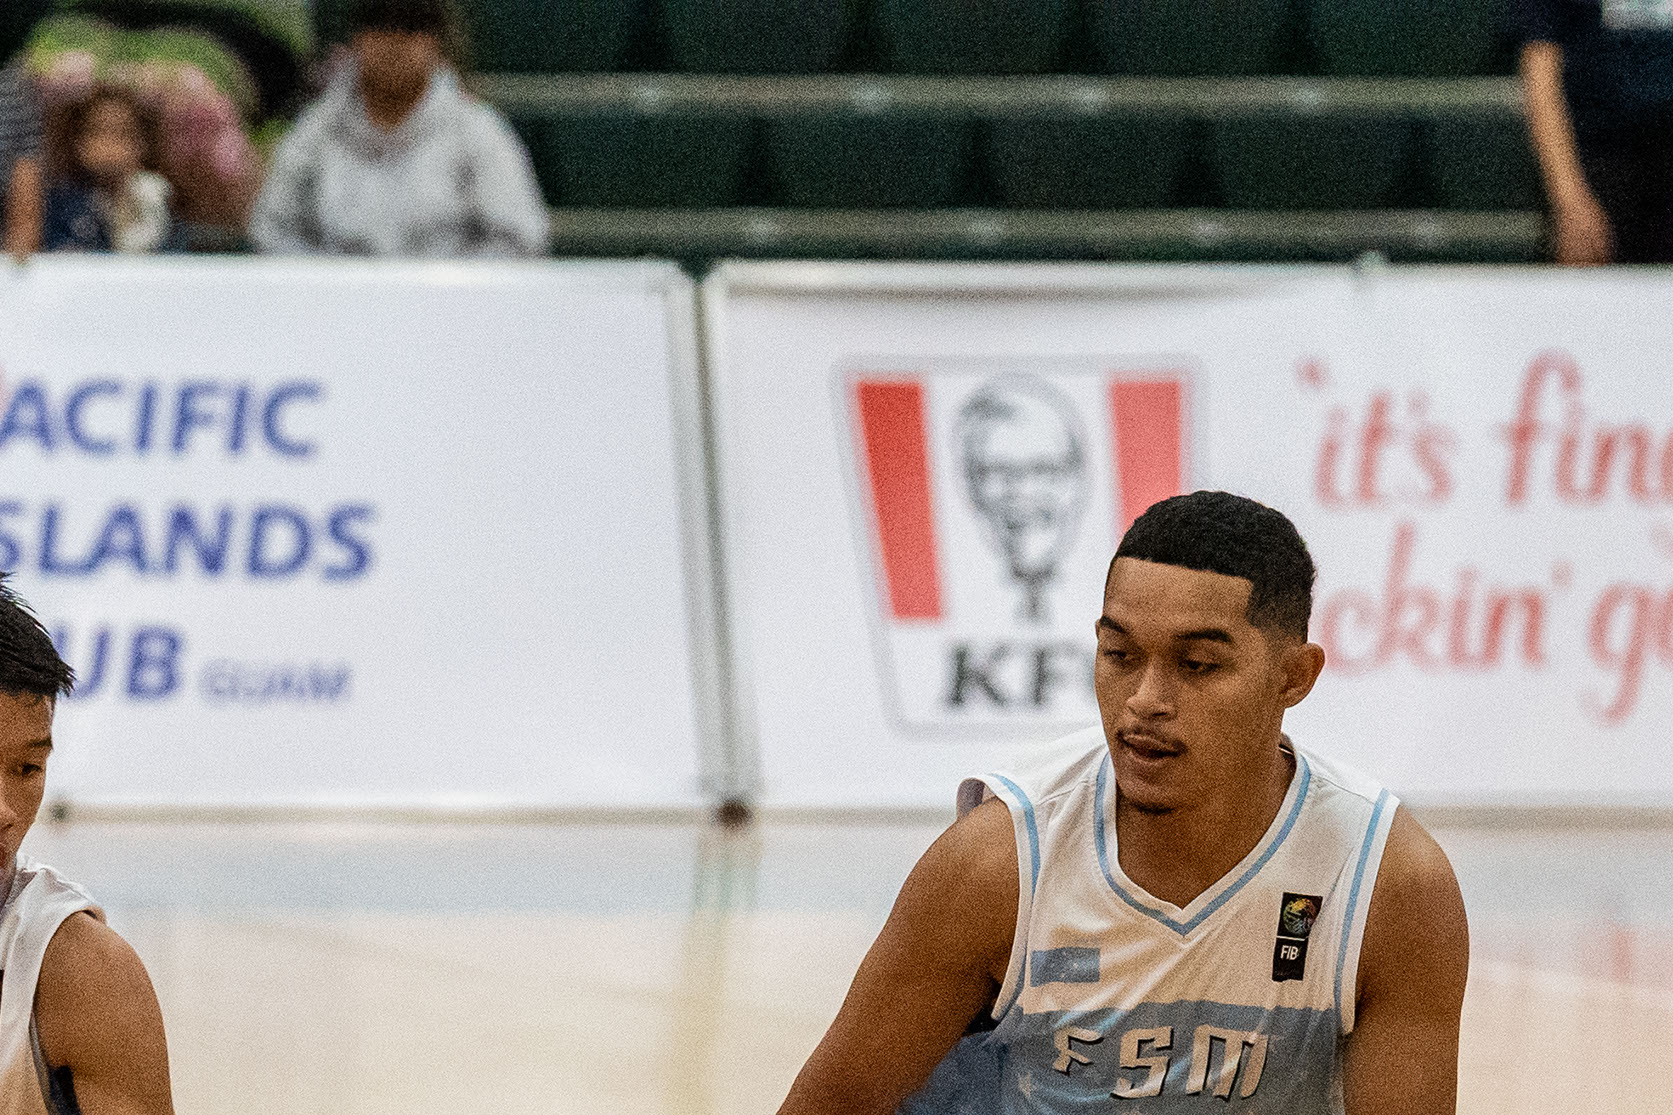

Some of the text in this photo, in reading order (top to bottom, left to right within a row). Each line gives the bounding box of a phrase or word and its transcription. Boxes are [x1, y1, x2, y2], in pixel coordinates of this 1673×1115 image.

[1493, 350, 1673, 512] fin
[945, 640, 1096, 708] KF
[1280, 944, 1301, 960] FIB
[1052, 1025, 1269, 1100] FSM
